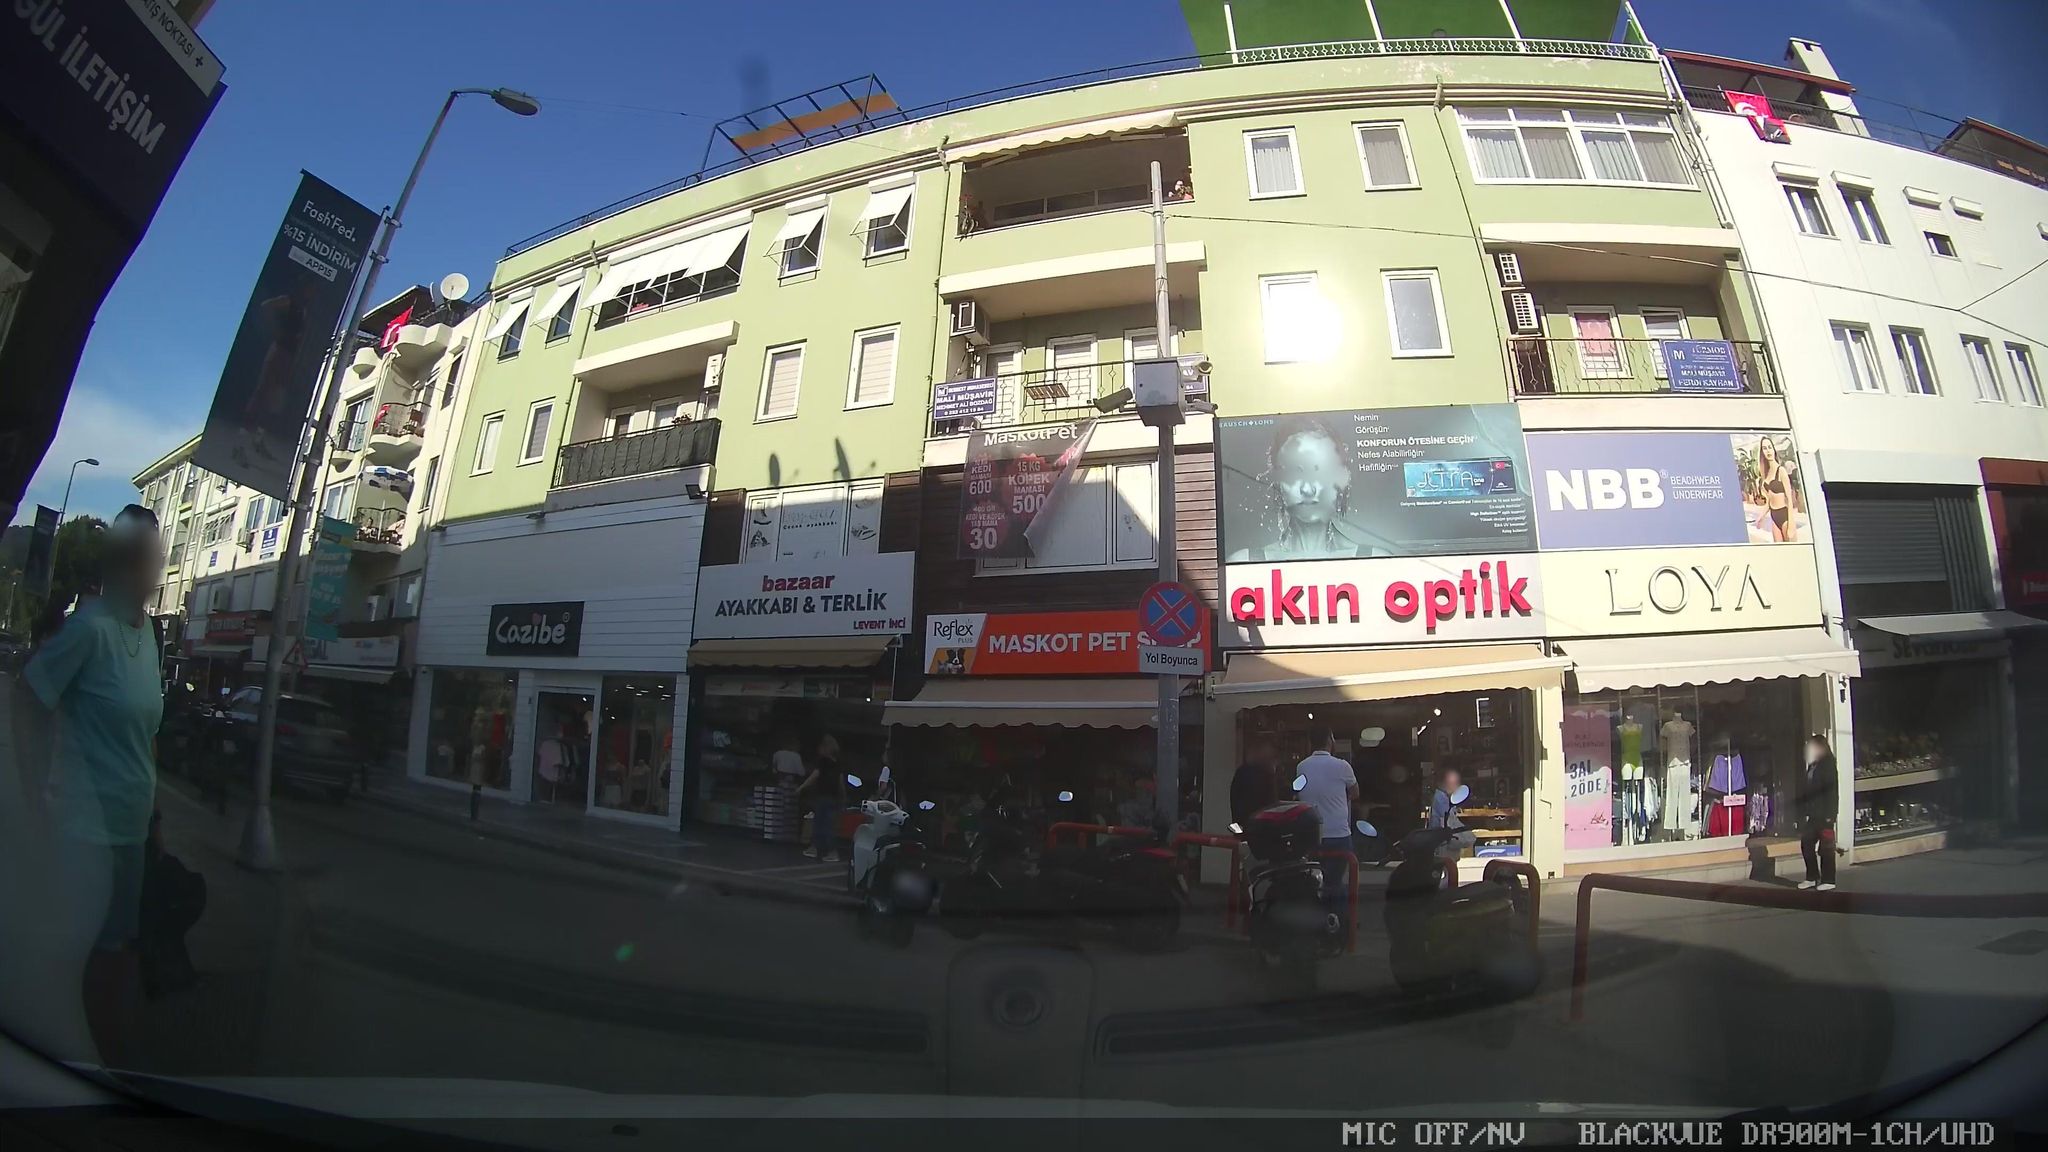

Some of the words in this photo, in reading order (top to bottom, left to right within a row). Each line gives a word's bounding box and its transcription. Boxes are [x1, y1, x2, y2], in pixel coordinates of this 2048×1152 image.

[158, 11, 195, 57] NOKTASI
[59, 25, 166, 154] İLETİŞİM
[284, 224, 306, 243] %15
[306, 233, 357, 273] İNDİRİM
[306, 259, 333, 278] APP15
[936, 395, 956, 404] MALİ
[957, 390, 994, 401] MÜŞAVİR
[1357, 438, 1407, 448] KONFORUN
[1408, 435, 1446, 446] ÖTESİNE
[1358, 450, 1381, 459] Nefes
[1017, 462, 1028, 472] 15
[1029, 461, 1041, 473] KG
[969, 479, 992, 495] 600
[1014, 485, 1045, 494] MAMASI
[1545, 468, 1665, 512] NBB
[1670, 475, 1721, 486] BEACHWEAR
[1012, 493, 1047, 514] 500
[1672, 489, 1724, 500] UNDERWEAR
[970, 527, 998, 550] 30
[762, 574, 836, 592] bazaar
[715, 596, 798, 617] AYAKKABI
[802, 597, 817, 614] &
[820, 588, 887, 613] TERLİK
[1231, 568, 1360, 625] akın
[1385, 560, 1532, 633] optik
[495, 611, 566, 645] Cazibe
[853, 620, 886, 630] LEVENT
[889, 616, 906, 629] İNCİ
[933, 619, 974, 641] Reflex
[989, 632, 1086, 654] MASKOT
[1088, 631, 1130, 652] PET
[1145, 652, 1159, 664] Yol
[1161, 653, 1198, 668] Boyunca
